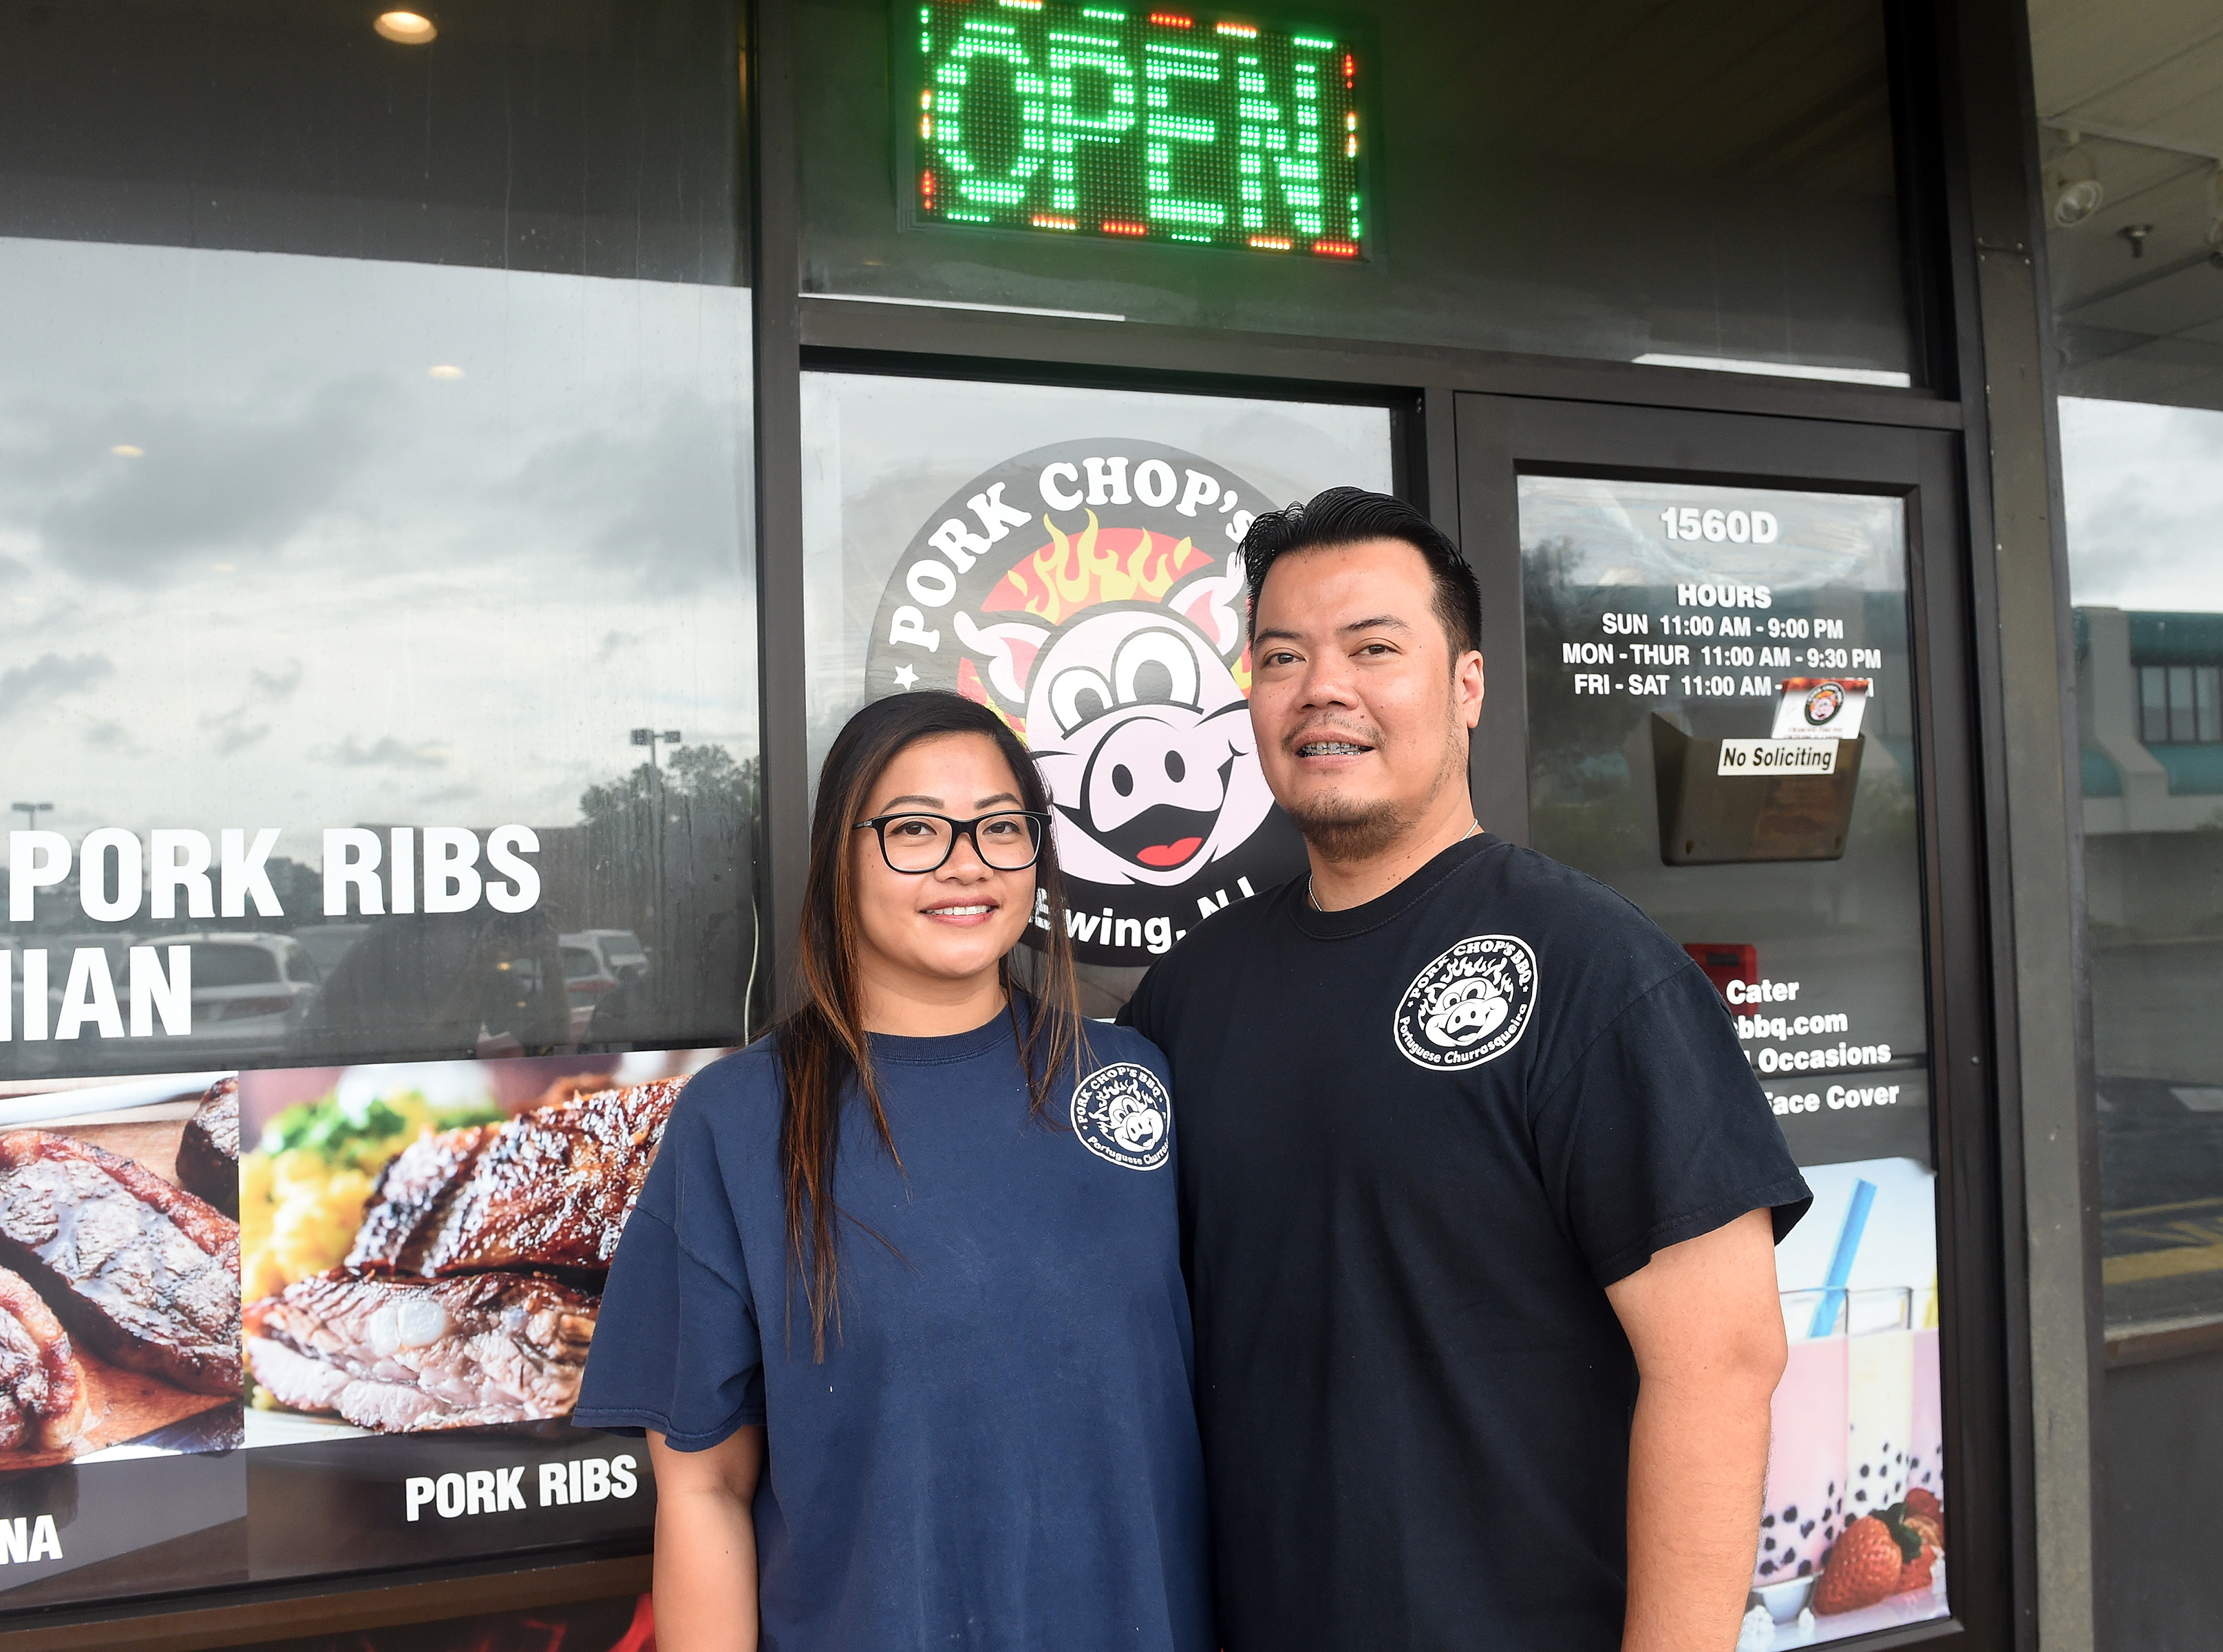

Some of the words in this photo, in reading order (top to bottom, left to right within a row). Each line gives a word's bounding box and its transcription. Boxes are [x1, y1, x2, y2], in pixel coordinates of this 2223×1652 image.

[937, 21, 1322, 235] OPEN
[1660, 506, 1779, 544] 1560D
[889, 480, 1032, 653] PORK
[1039, 456, 1257, 544] CHOP'S
[1677, 583, 1772, 609] HOURS
[1602, 613, 1648, 635] SUN
[1659, 615, 1714, 637] 11:00
[1719, 616, 1752, 637] AM
[1767, 617, 1810, 639] 9:00
[1814, 618, 1844, 639] PM
[1562, 642, 1614, 665] MON
[1630, 644, 1690, 666] THUR
[1701, 645, 1754, 667] 11:00
[1758, 646, 1791, 668] AM
[1807, 648, 1849, 670] 9:30
[1851, 648, 1882, 670] PM
[1574, 673, 1610, 695] FRI
[1628, 674, 1670, 696] SAT
[1681, 675, 1736, 697] 11:00
[1739, 675, 1773, 697] AM
[1723, 748, 1747, 767] No
[1752, 747, 1832, 771] Soliciting
[8, 827, 285, 922] PORK
[323, 824, 542, 916] RIBS
[1410, 955, 1450, 999] PORK
[1453, 940, 1516, 956] CHOP'S
[1510, 949, 1532, 986] BBQ
[1726, 979, 1800, 1005] Cater
[1399, 1015, 1442, 1063] Portuguese
[1444, 1003, 1528, 1063] Churrasqueira
[1758, 1042, 1892, 1074] Occasions
[1076, 1088, 1093, 1125] PORK
[1090, 1067, 1138, 1090] CHOP'S
[1138, 1072, 1162, 1099] BBQ
[1826, 1085, 1900, 1110] Cover
[1087, 1136, 1143, 1165] Portuguese
[405, 1465, 527, 1523] PORK
[538, 1454, 638, 1507] RIBS
